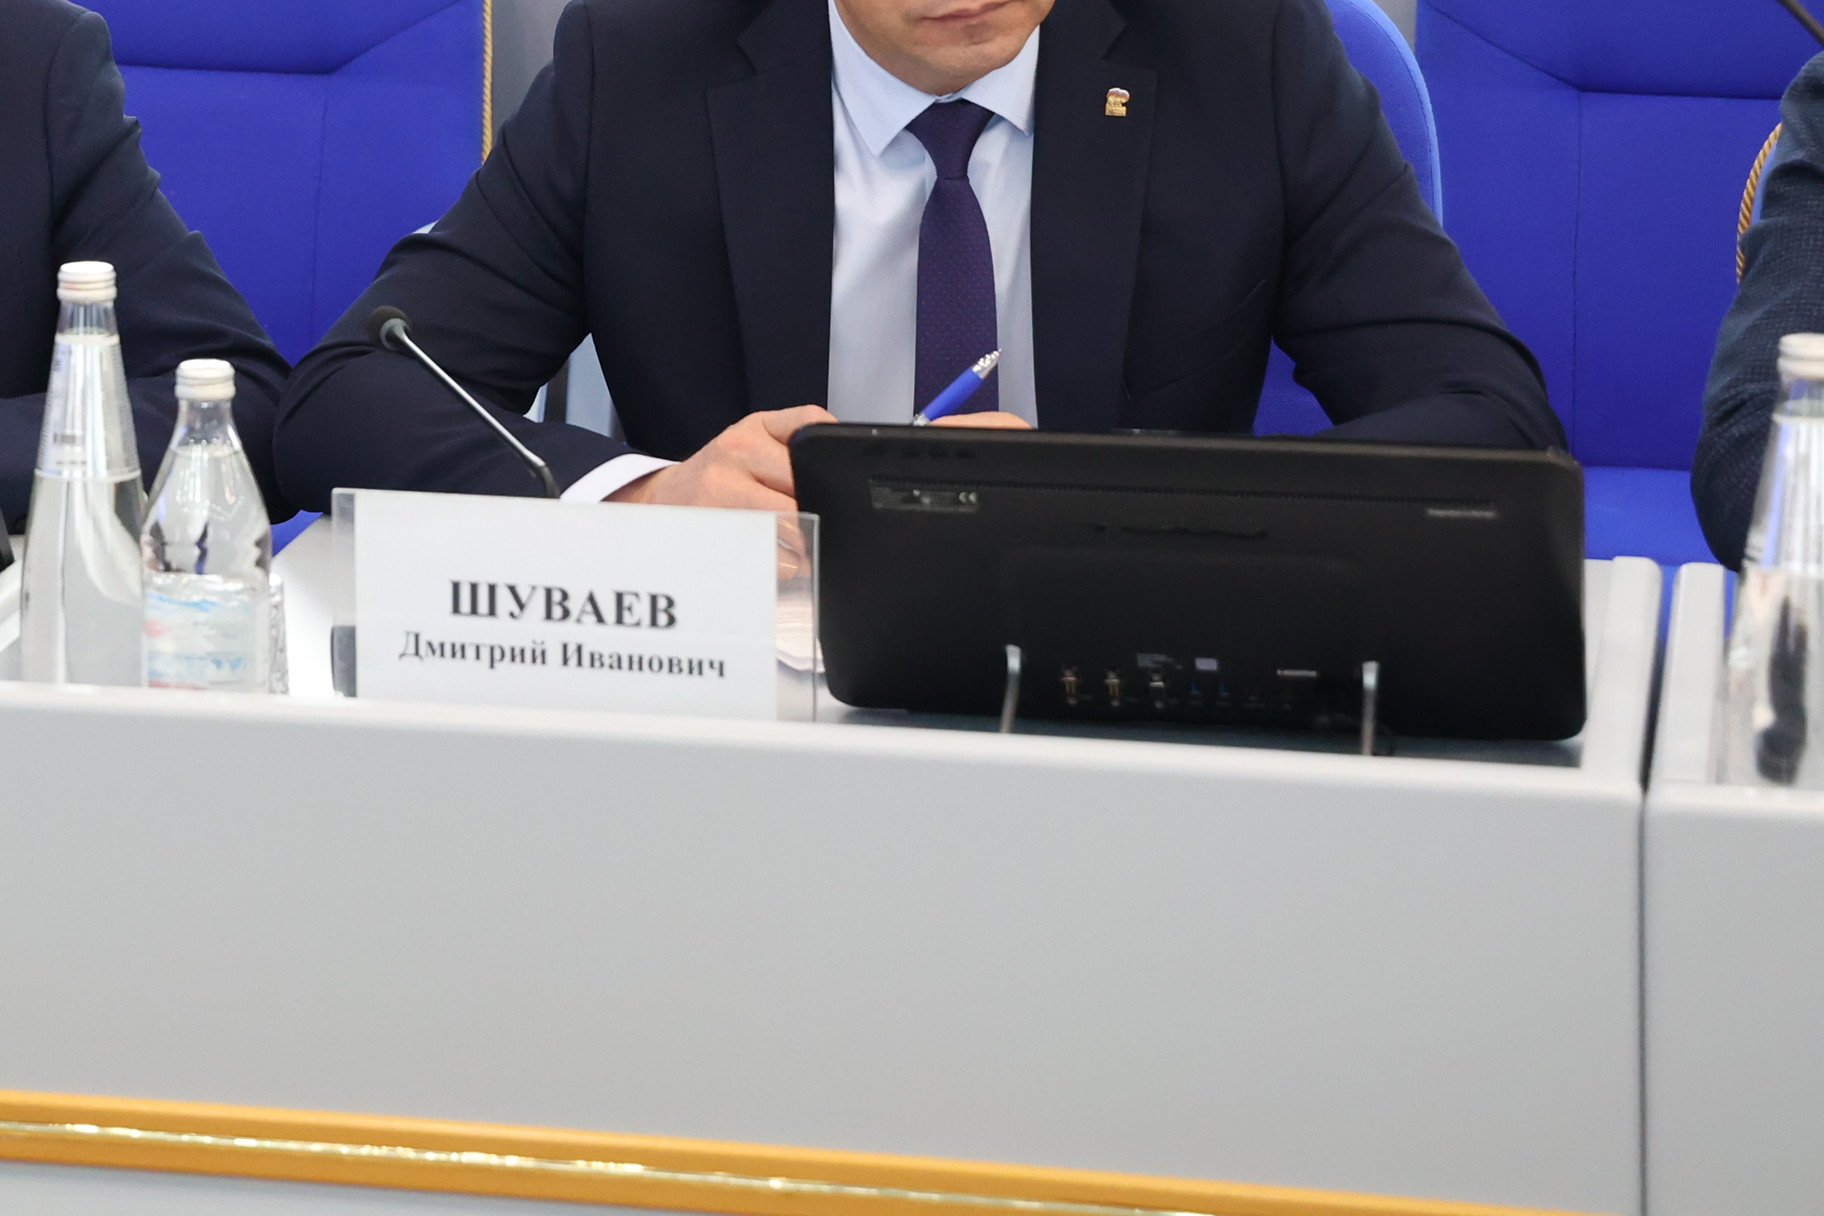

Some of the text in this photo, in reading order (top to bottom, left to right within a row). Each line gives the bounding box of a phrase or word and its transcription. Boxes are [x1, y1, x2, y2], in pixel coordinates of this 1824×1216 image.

[449, 580, 677, 629] ШУВАЕВ
[398, 631, 726, 679] Дмитрий Иванович
